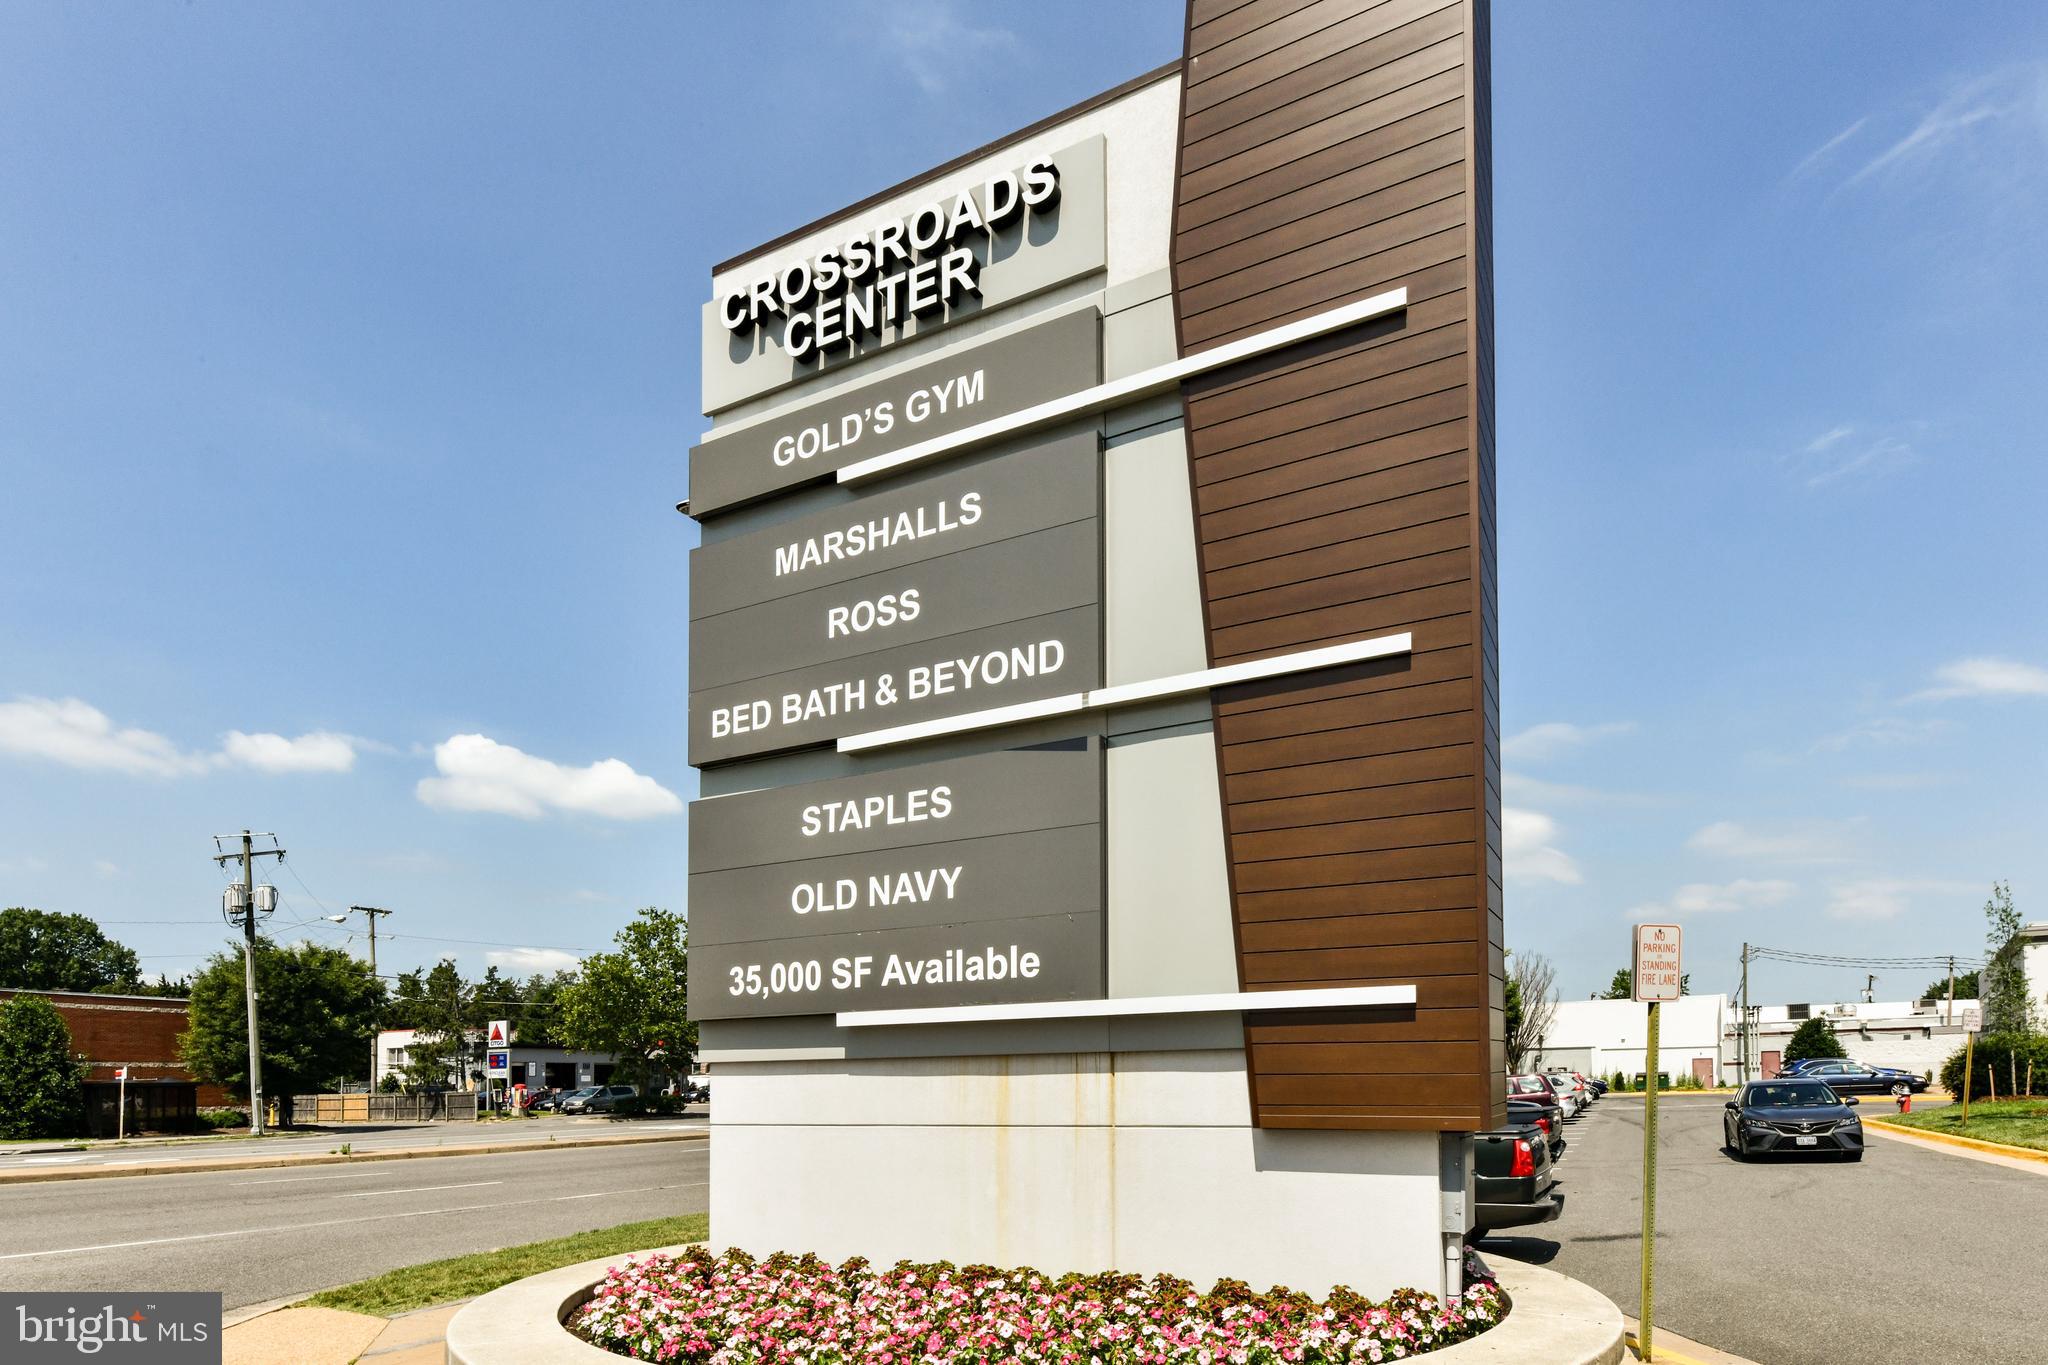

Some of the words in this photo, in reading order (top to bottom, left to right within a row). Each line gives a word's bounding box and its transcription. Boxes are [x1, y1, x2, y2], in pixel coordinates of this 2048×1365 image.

[720, 155, 1056, 330] CROSSROADS
[783, 248, 977, 358] CENTER
[905, 369, 985, 424] GYM
[775, 492, 983, 577] MARSHALLS
[828, 588, 921, 639] ROSS
[711, 699, 772, 738] BED
[782, 679, 866, 725] BATH
[875, 673, 899, 707] &
[908, 639, 1065, 700] BEYOND
[801, 785, 953, 836] STAPLES
[791, 879, 857, 914] OLD
[869, 866, 963, 907] NAVY
[1643, 943, 1676, 953] PARKING
[1654, 931, 1666, 941] NO
[728, 960, 822, 999] 35,000
[831, 956, 873, 989] SF
[881, 945, 1041, 987] Available
[1641, 960, 1677, 970] STANDING
[1641, 973, 1656, 985] FIRE
[1658, 973, 1676, 985] LANE
